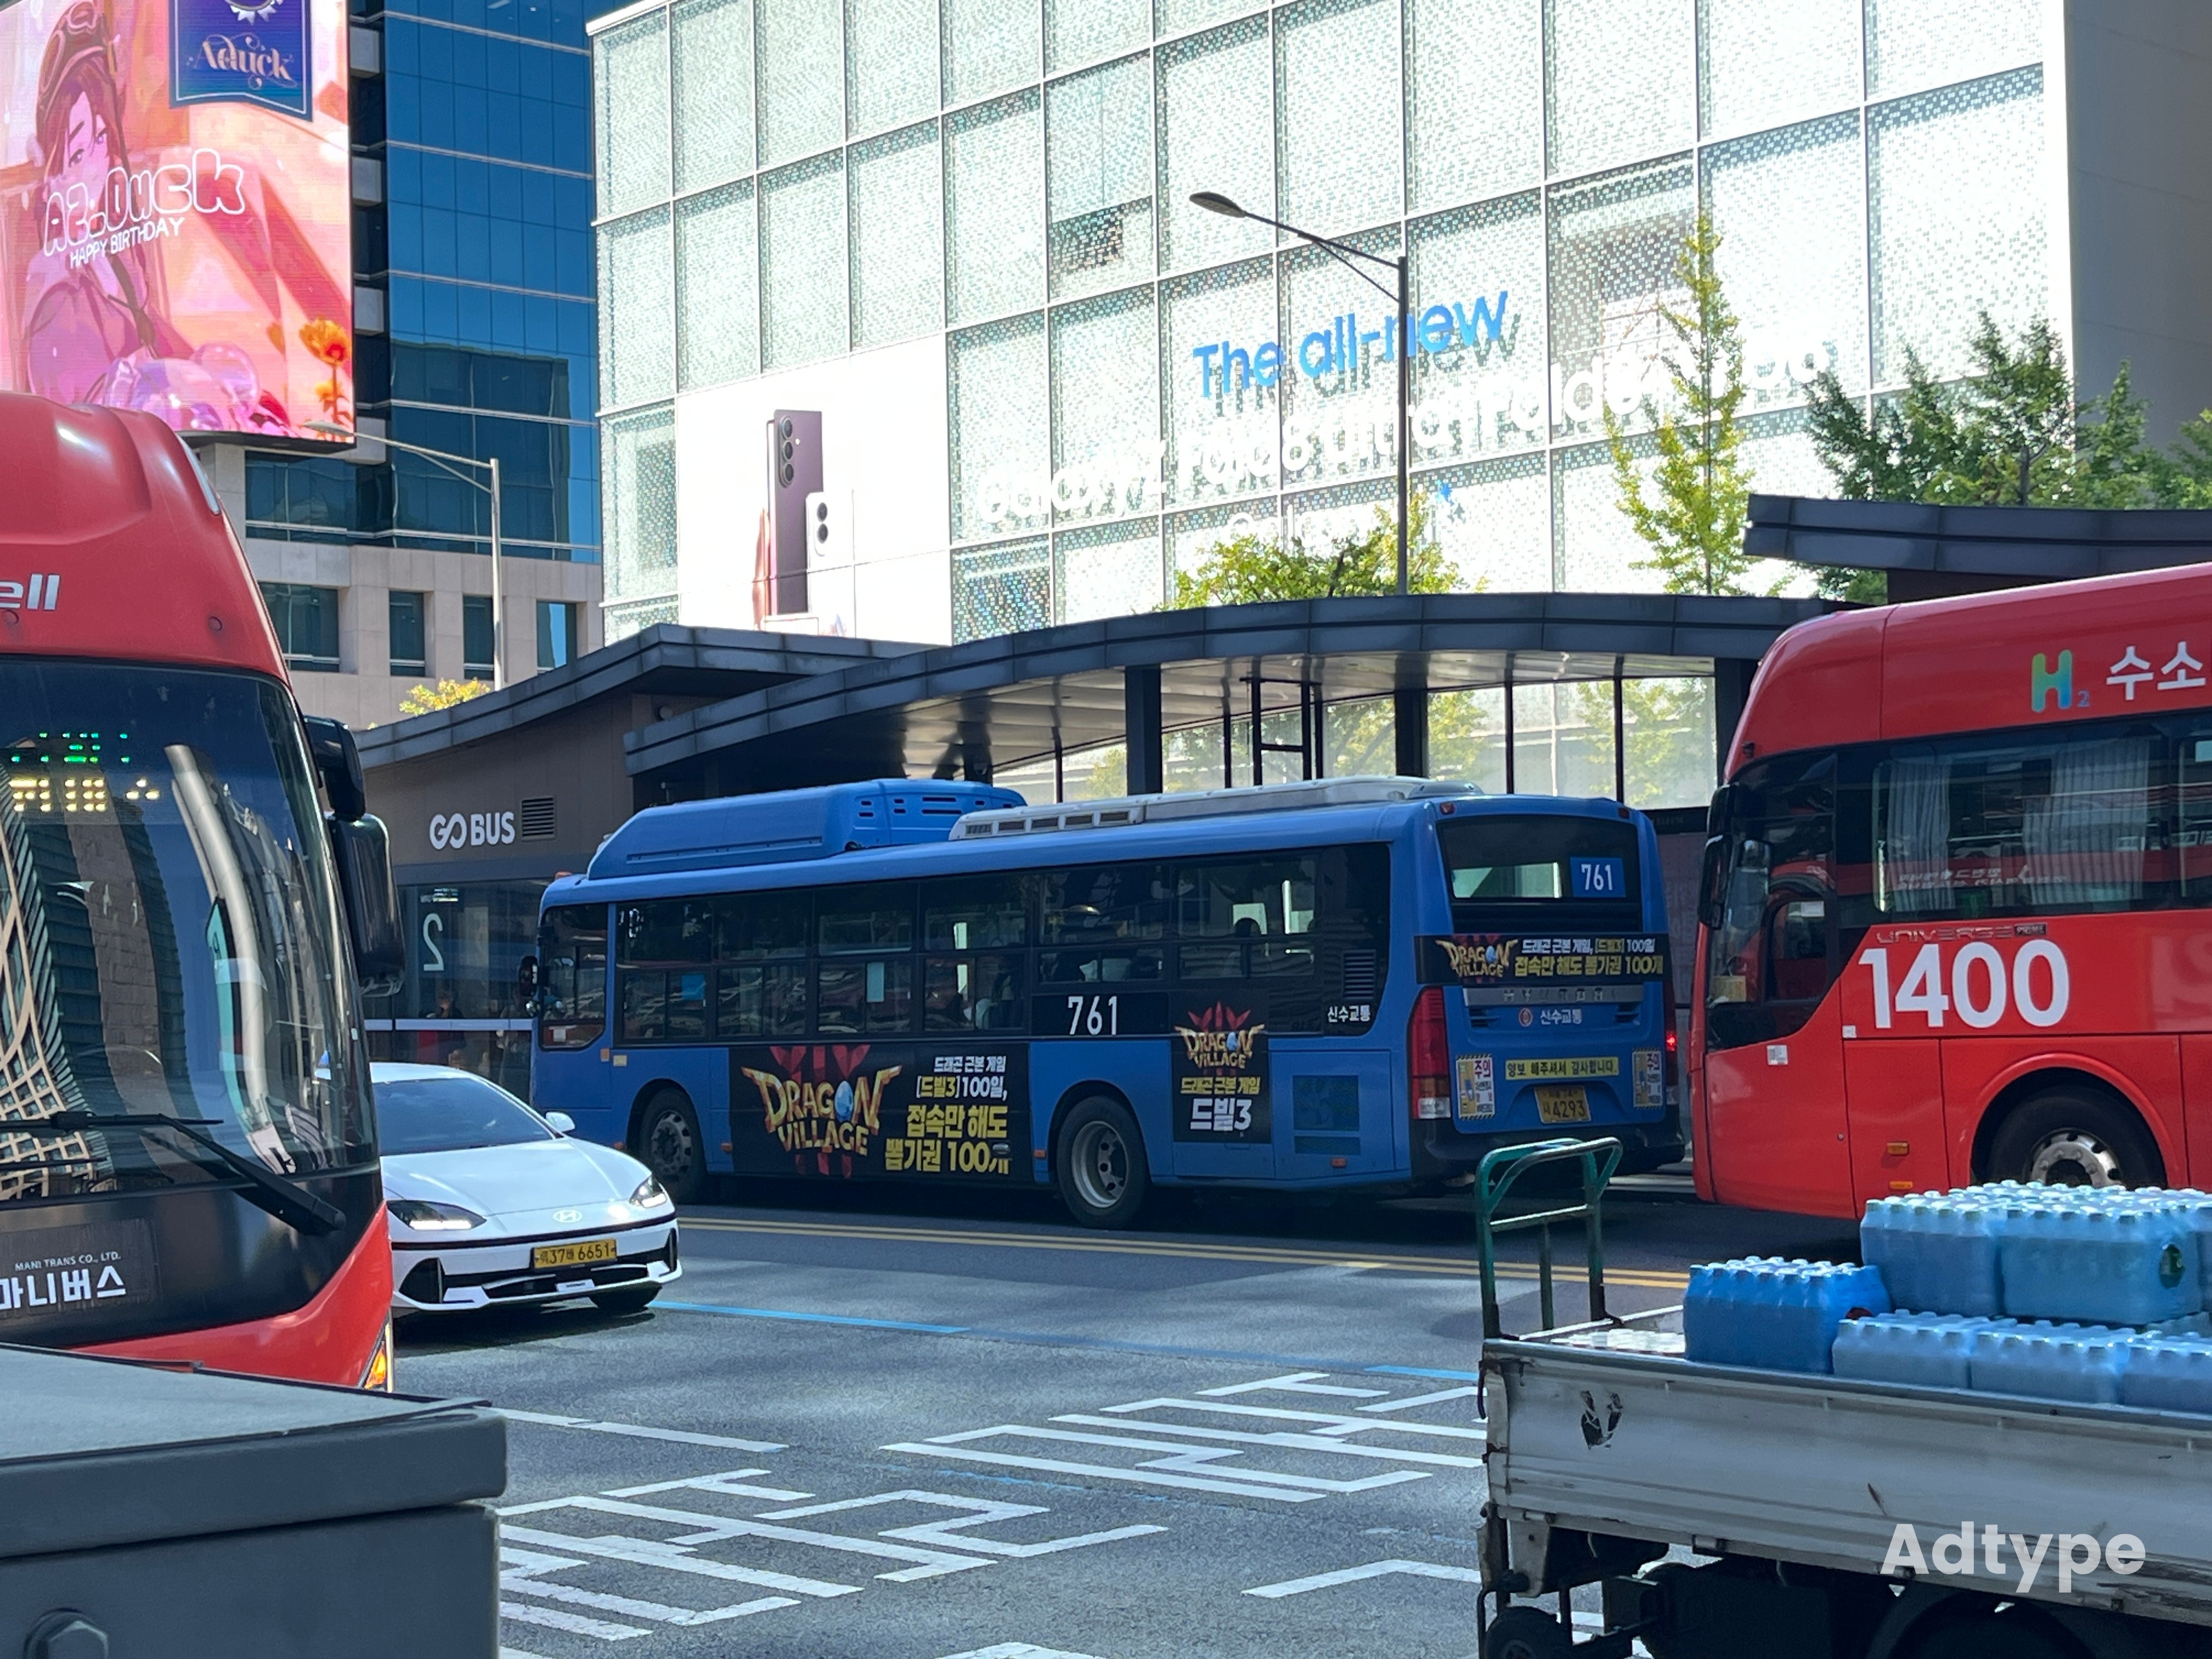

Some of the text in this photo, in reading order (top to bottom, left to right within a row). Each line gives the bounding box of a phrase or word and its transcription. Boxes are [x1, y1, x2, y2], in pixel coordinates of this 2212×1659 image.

[70, 217, 185, 269] HAPPY BIRTHDAY
[1193, 291, 1508, 397] The all-new
[2107, 641, 2206, 700] 수소
[1581, 864, 1613, 890] 761
[1876, 924, 2012, 944] UNIVERSE
[1435, 939, 1518, 970] DRAGON
[1859, 940, 2069, 1029] 1400
[1067, 996, 1118, 1035] 761
[1328, 1005, 1370, 1022] 신수교통
[1541, 1009, 1582, 1025] 신수교통
[1174, 1024, 1265, 1059] DRAGON
[934, 1056, 1006, 1073] 드래곤 근본 게임
[1193, 1052, 1246, 1069] VILLAGE
[1508, 1062, 1526, 1077] 양보
[741, 1065, 902, 1135] DRAGON
[1181, 1077, 1213, 1094] 드래곤
[1237, 1077, 1260, 1094] 게임
[907, 1104, 1008, 1138] 접속만 해도
[1190, 1098, 1252, 1131] 드빌3
[777, 1120, 868, 1155] VILLAGE
[885, 1138, 941, 1172] 뽑기권
[15, 1260, 42, 1272] MANI
[44, 1256, 77, 1267] TRANS
[100, 1251, 122, 1262] LTD.
[578, 1243, 610, 1261] 6651
